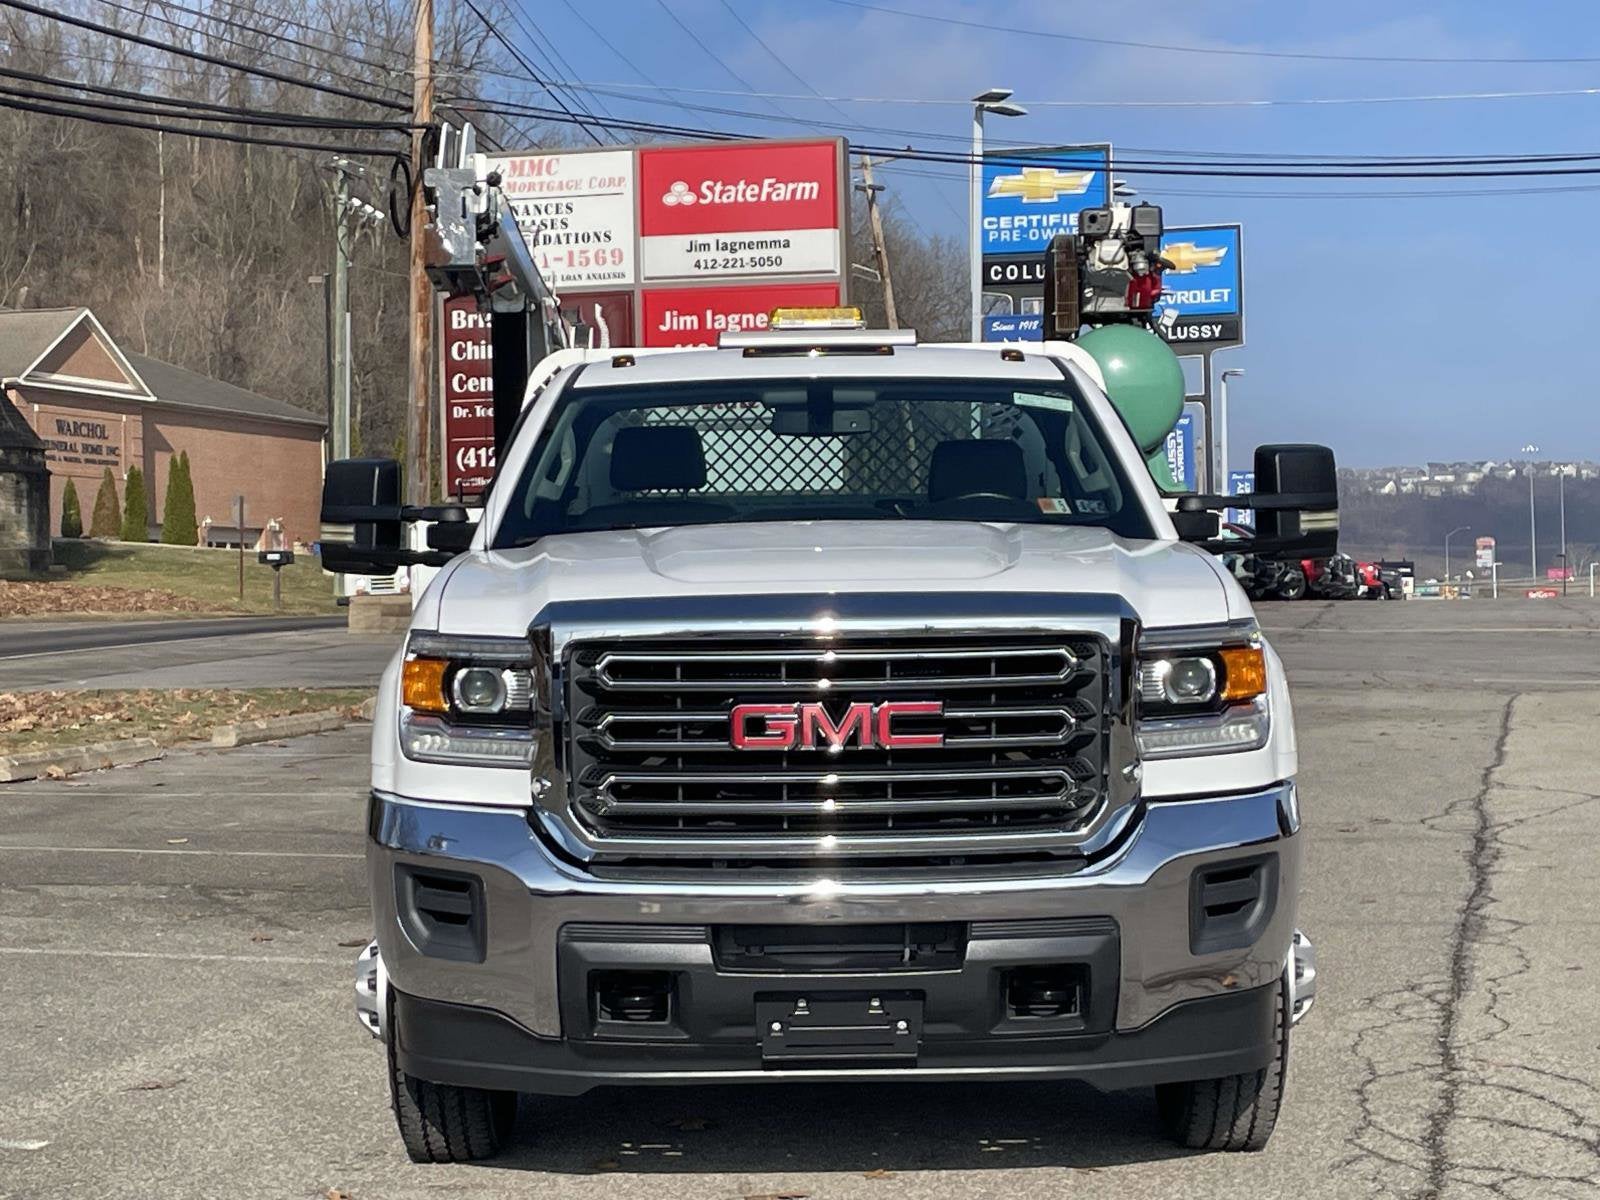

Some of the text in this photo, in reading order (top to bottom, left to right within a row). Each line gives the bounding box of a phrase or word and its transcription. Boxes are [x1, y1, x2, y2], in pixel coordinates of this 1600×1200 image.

[507, 157, 560, 178] MMC
[505, 179, 583, 194] MORTGAGE
[686, 238, 791, 254] Jim Iagnemma
[694, 255, 783, 270] 412-221-5050
[659, 309, 699, 332] Jim
[1160, 324, 1222, 340] LUSSY
[453, 406, 473, 418] Dr.
[56, 418, 109, 440] WARCHOL
[731, 701, 945, 751] GMC
